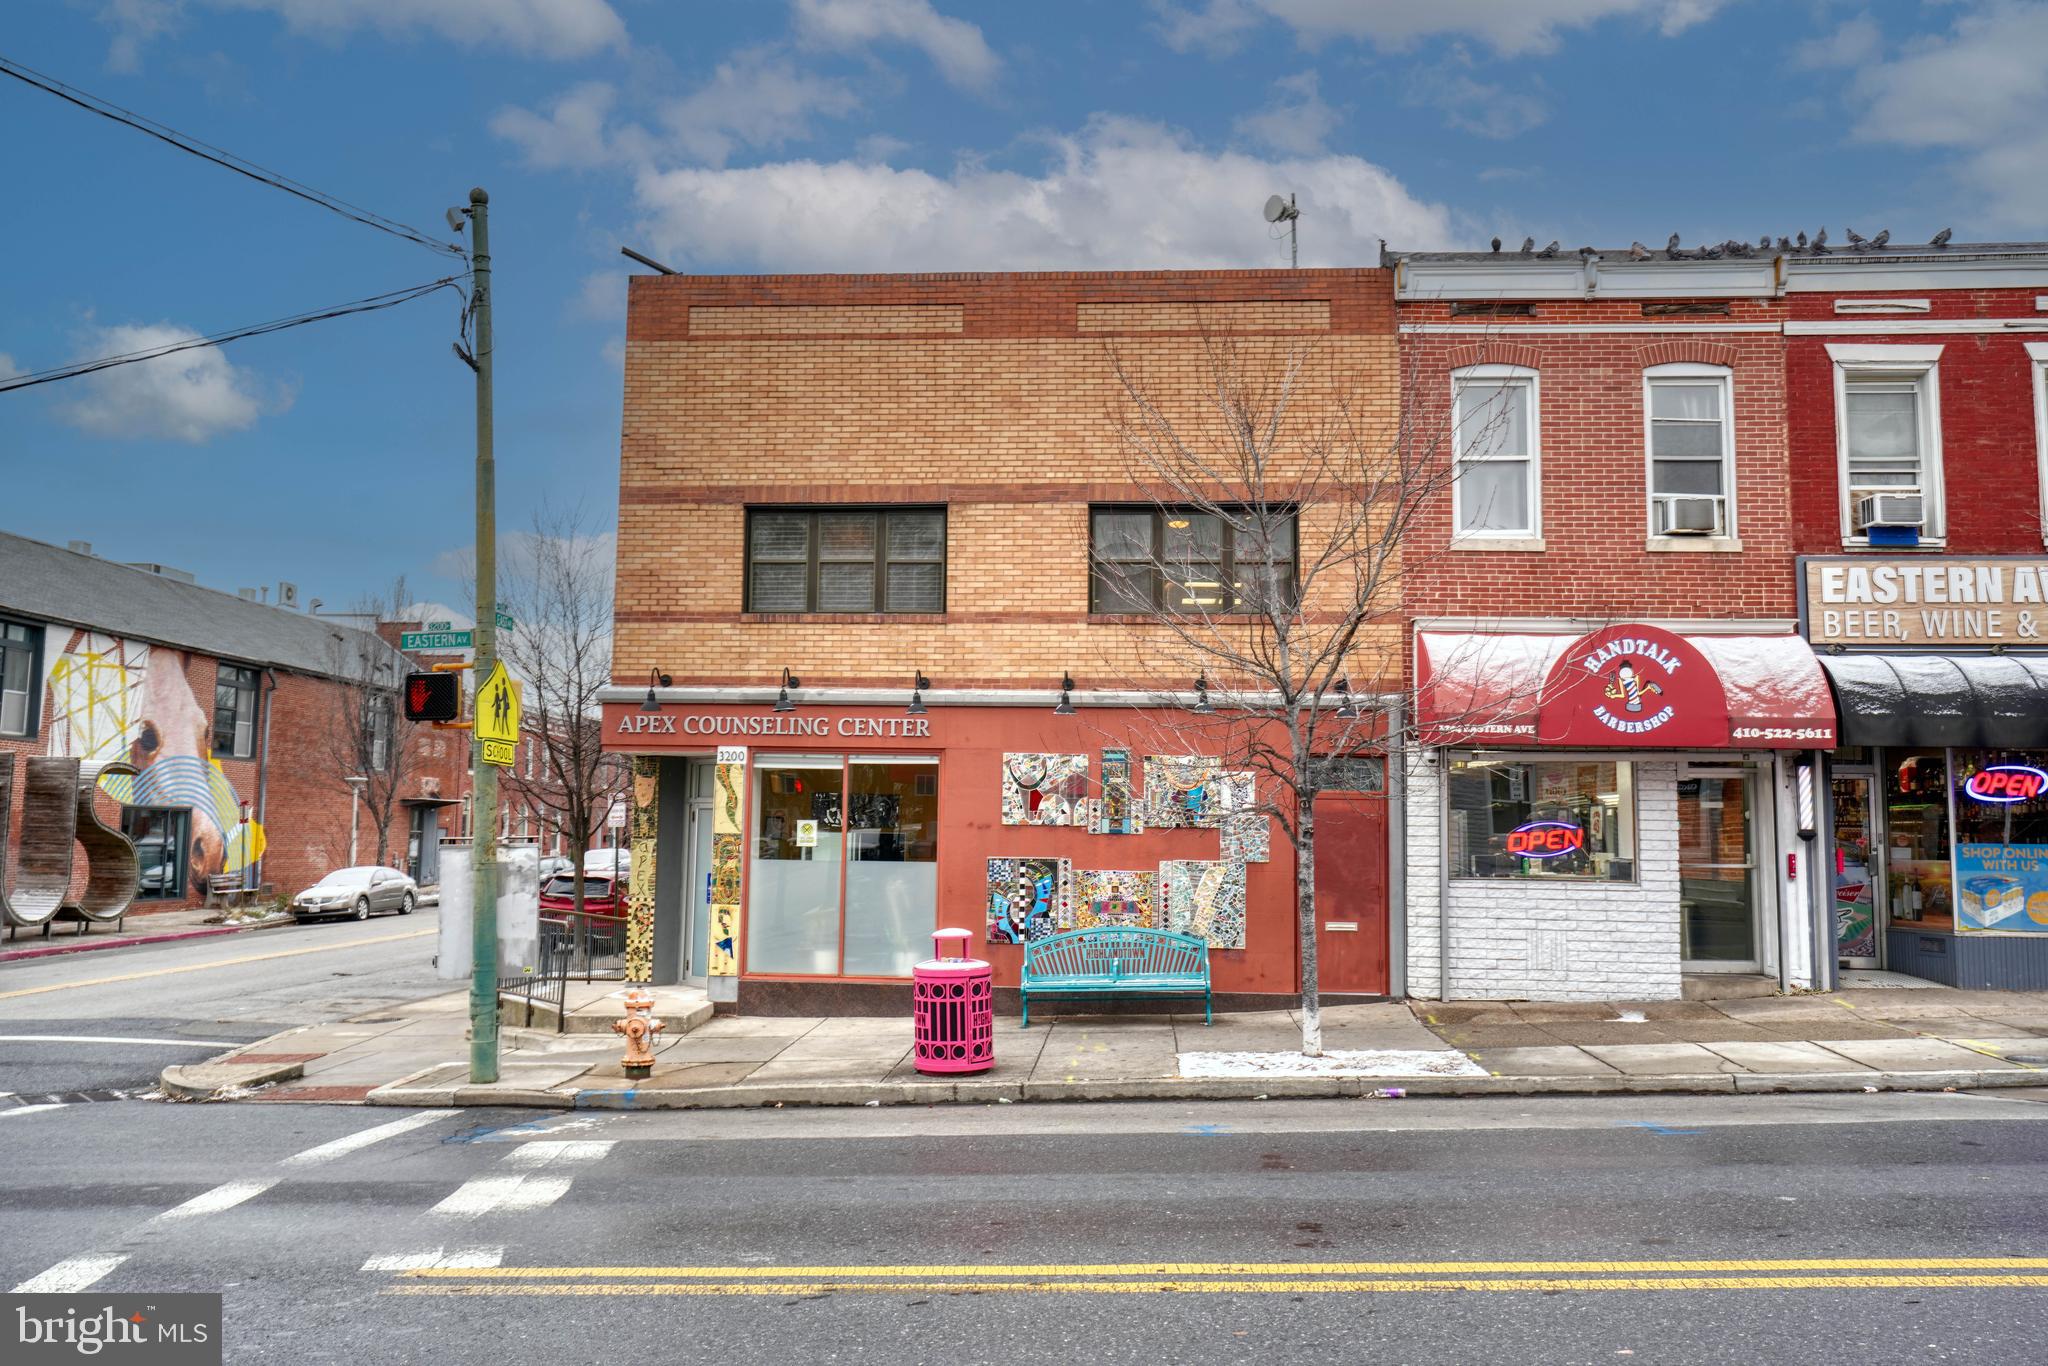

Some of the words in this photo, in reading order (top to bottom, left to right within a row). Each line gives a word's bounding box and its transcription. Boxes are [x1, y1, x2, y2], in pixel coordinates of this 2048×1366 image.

[1820, 566, 2003, 604] EASTERN
[1823, 610, 1909, 641] BEER,
[1920, 610, 2003, 638] WINE
[2016, 609, 2039, 639] &
[407, 634, 456, 648] EASTERN
[1583, 638, 1683, 676] HANDTALK
[617, 715, 677, 734] APEX
[683, 715, 829, 736] COUNSELING
[837, 718, 931, 737] CENTER
[1592, 704, 1675, 734] BARBERSHOP
[1514, 725, 1536, 734] AVE
[1732, 727, 1832, 740] 410-522-5611
[486, 743, 512, 761] SCHOOL
[718, 751, 745, 762] 3200
[1971, 771, 2042, 798] OPEN
[1507, 828, 1585, 853] OPEN
[1962, 847, 2000, 859] SHOP
[1982, 859, 2018, 871] WITH
[2021, 859, 2040, 871] US
